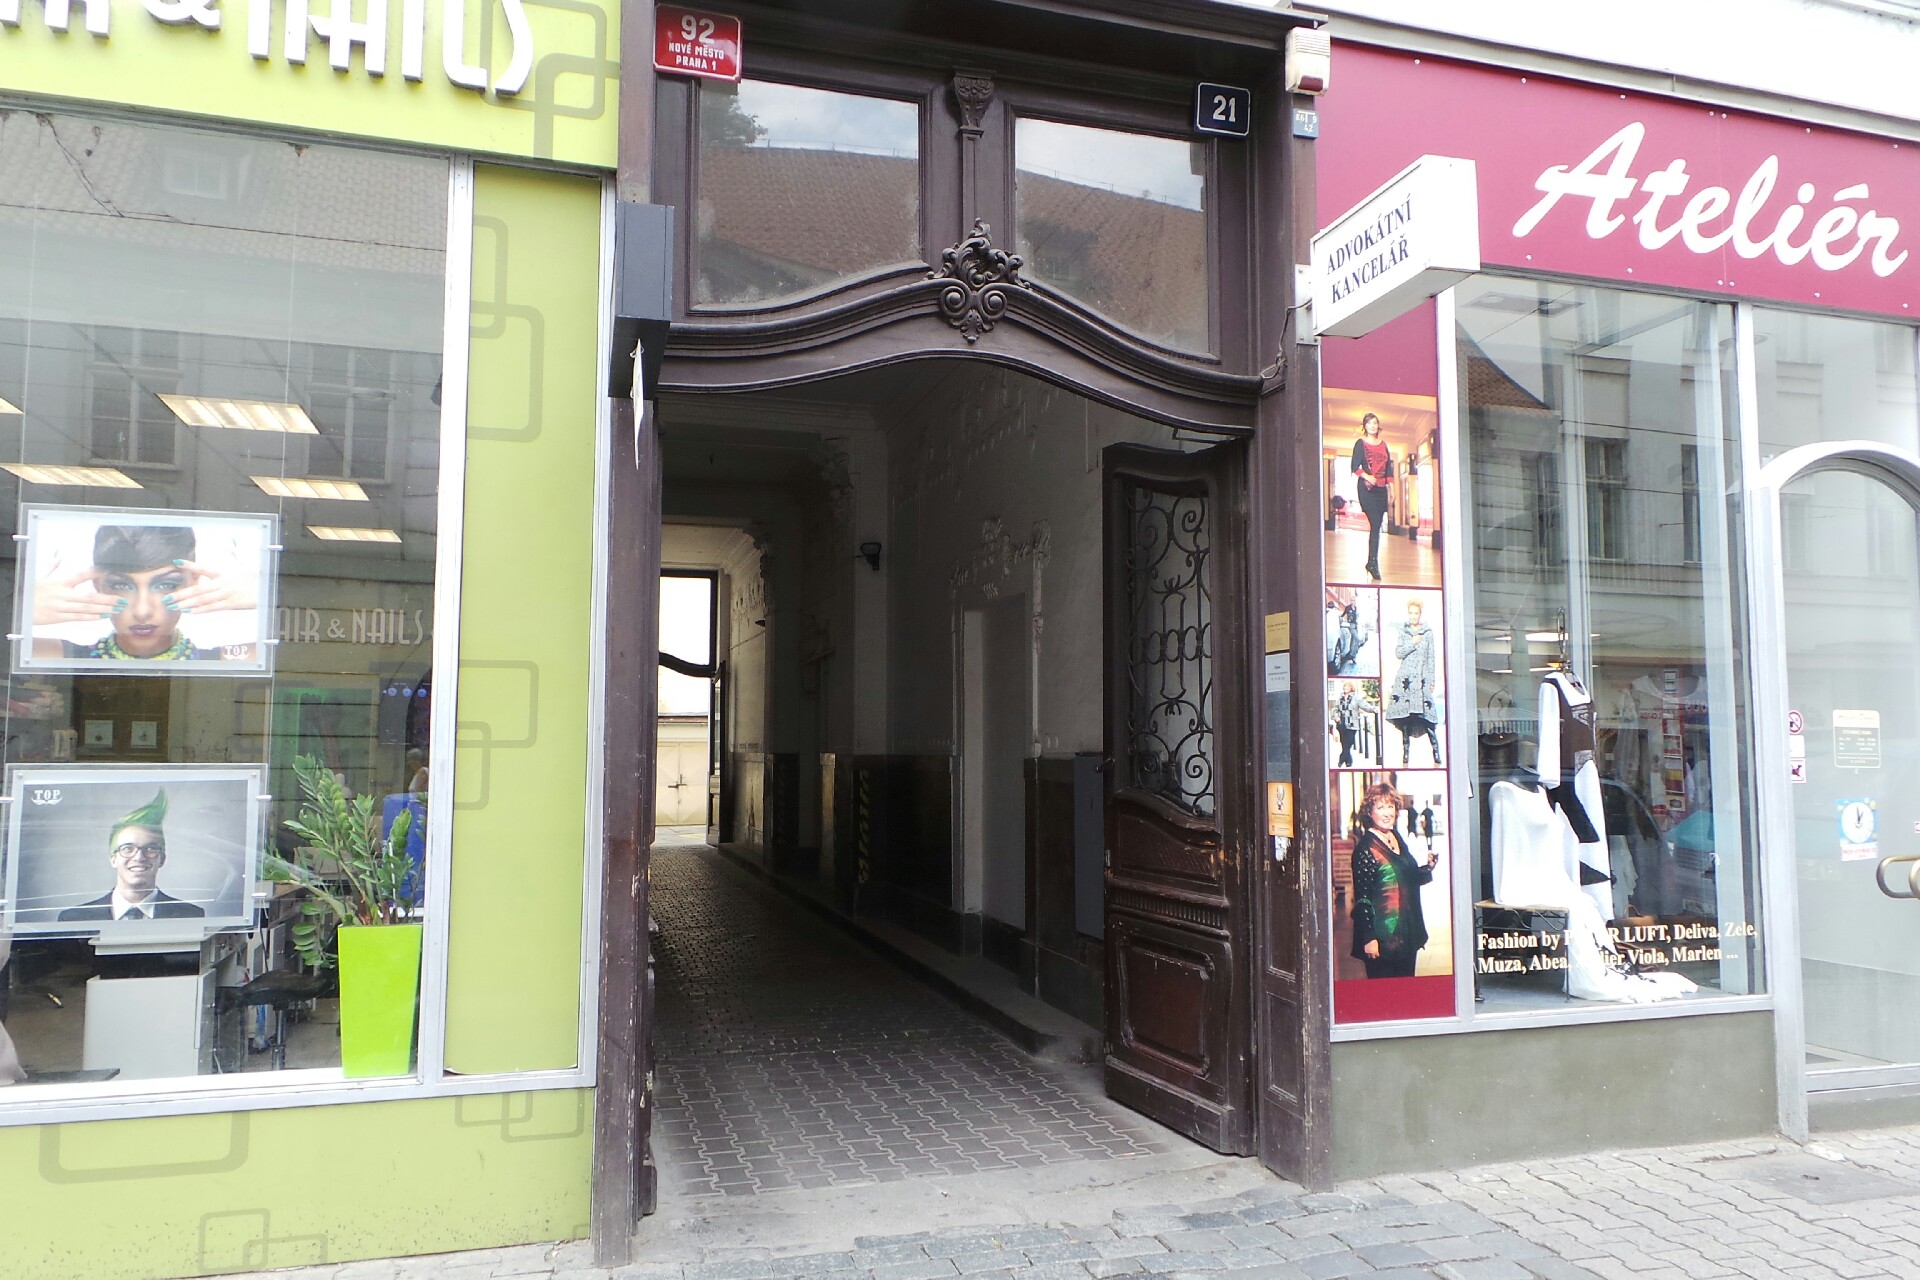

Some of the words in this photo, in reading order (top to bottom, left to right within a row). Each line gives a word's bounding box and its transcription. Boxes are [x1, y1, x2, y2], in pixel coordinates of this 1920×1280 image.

[681, 14, 715, 44] 92
[668, 42, 692, 54] NOVÉ
[695, 44, 725, 60] MĚSTO
[676, 55, 708, 70] PRAHA
[711, 60, 717, 71] 1
[1212, 94, 1236, 123] 21
[1512, 121, 1909, 278] Ateliér
[1326, 192, 1412, 275] ADVOKÁTNÍ
[1331, 232, 1410, 304] KANCELÁŘ
[326, 617, 346, 639] &
[352, 607, 425, 645] NAILS
[224, 644, 248, 656] TOP
[34, 789, 61, 800] TOP
[1477, 931, 1539, 951] Fashion
[1541, 930, 1561, 950] by
[1624, 924, 1672, 944] LUFT,
[1673, 922, 1722, 941] Deliva,
[1725, 921, 1759, 937] Zele,
[1477, 956, 1528, 975] Muza,
[1627, 948, 1670, 966] Viola,
[1672, 945, 1723, 963] Marlen
